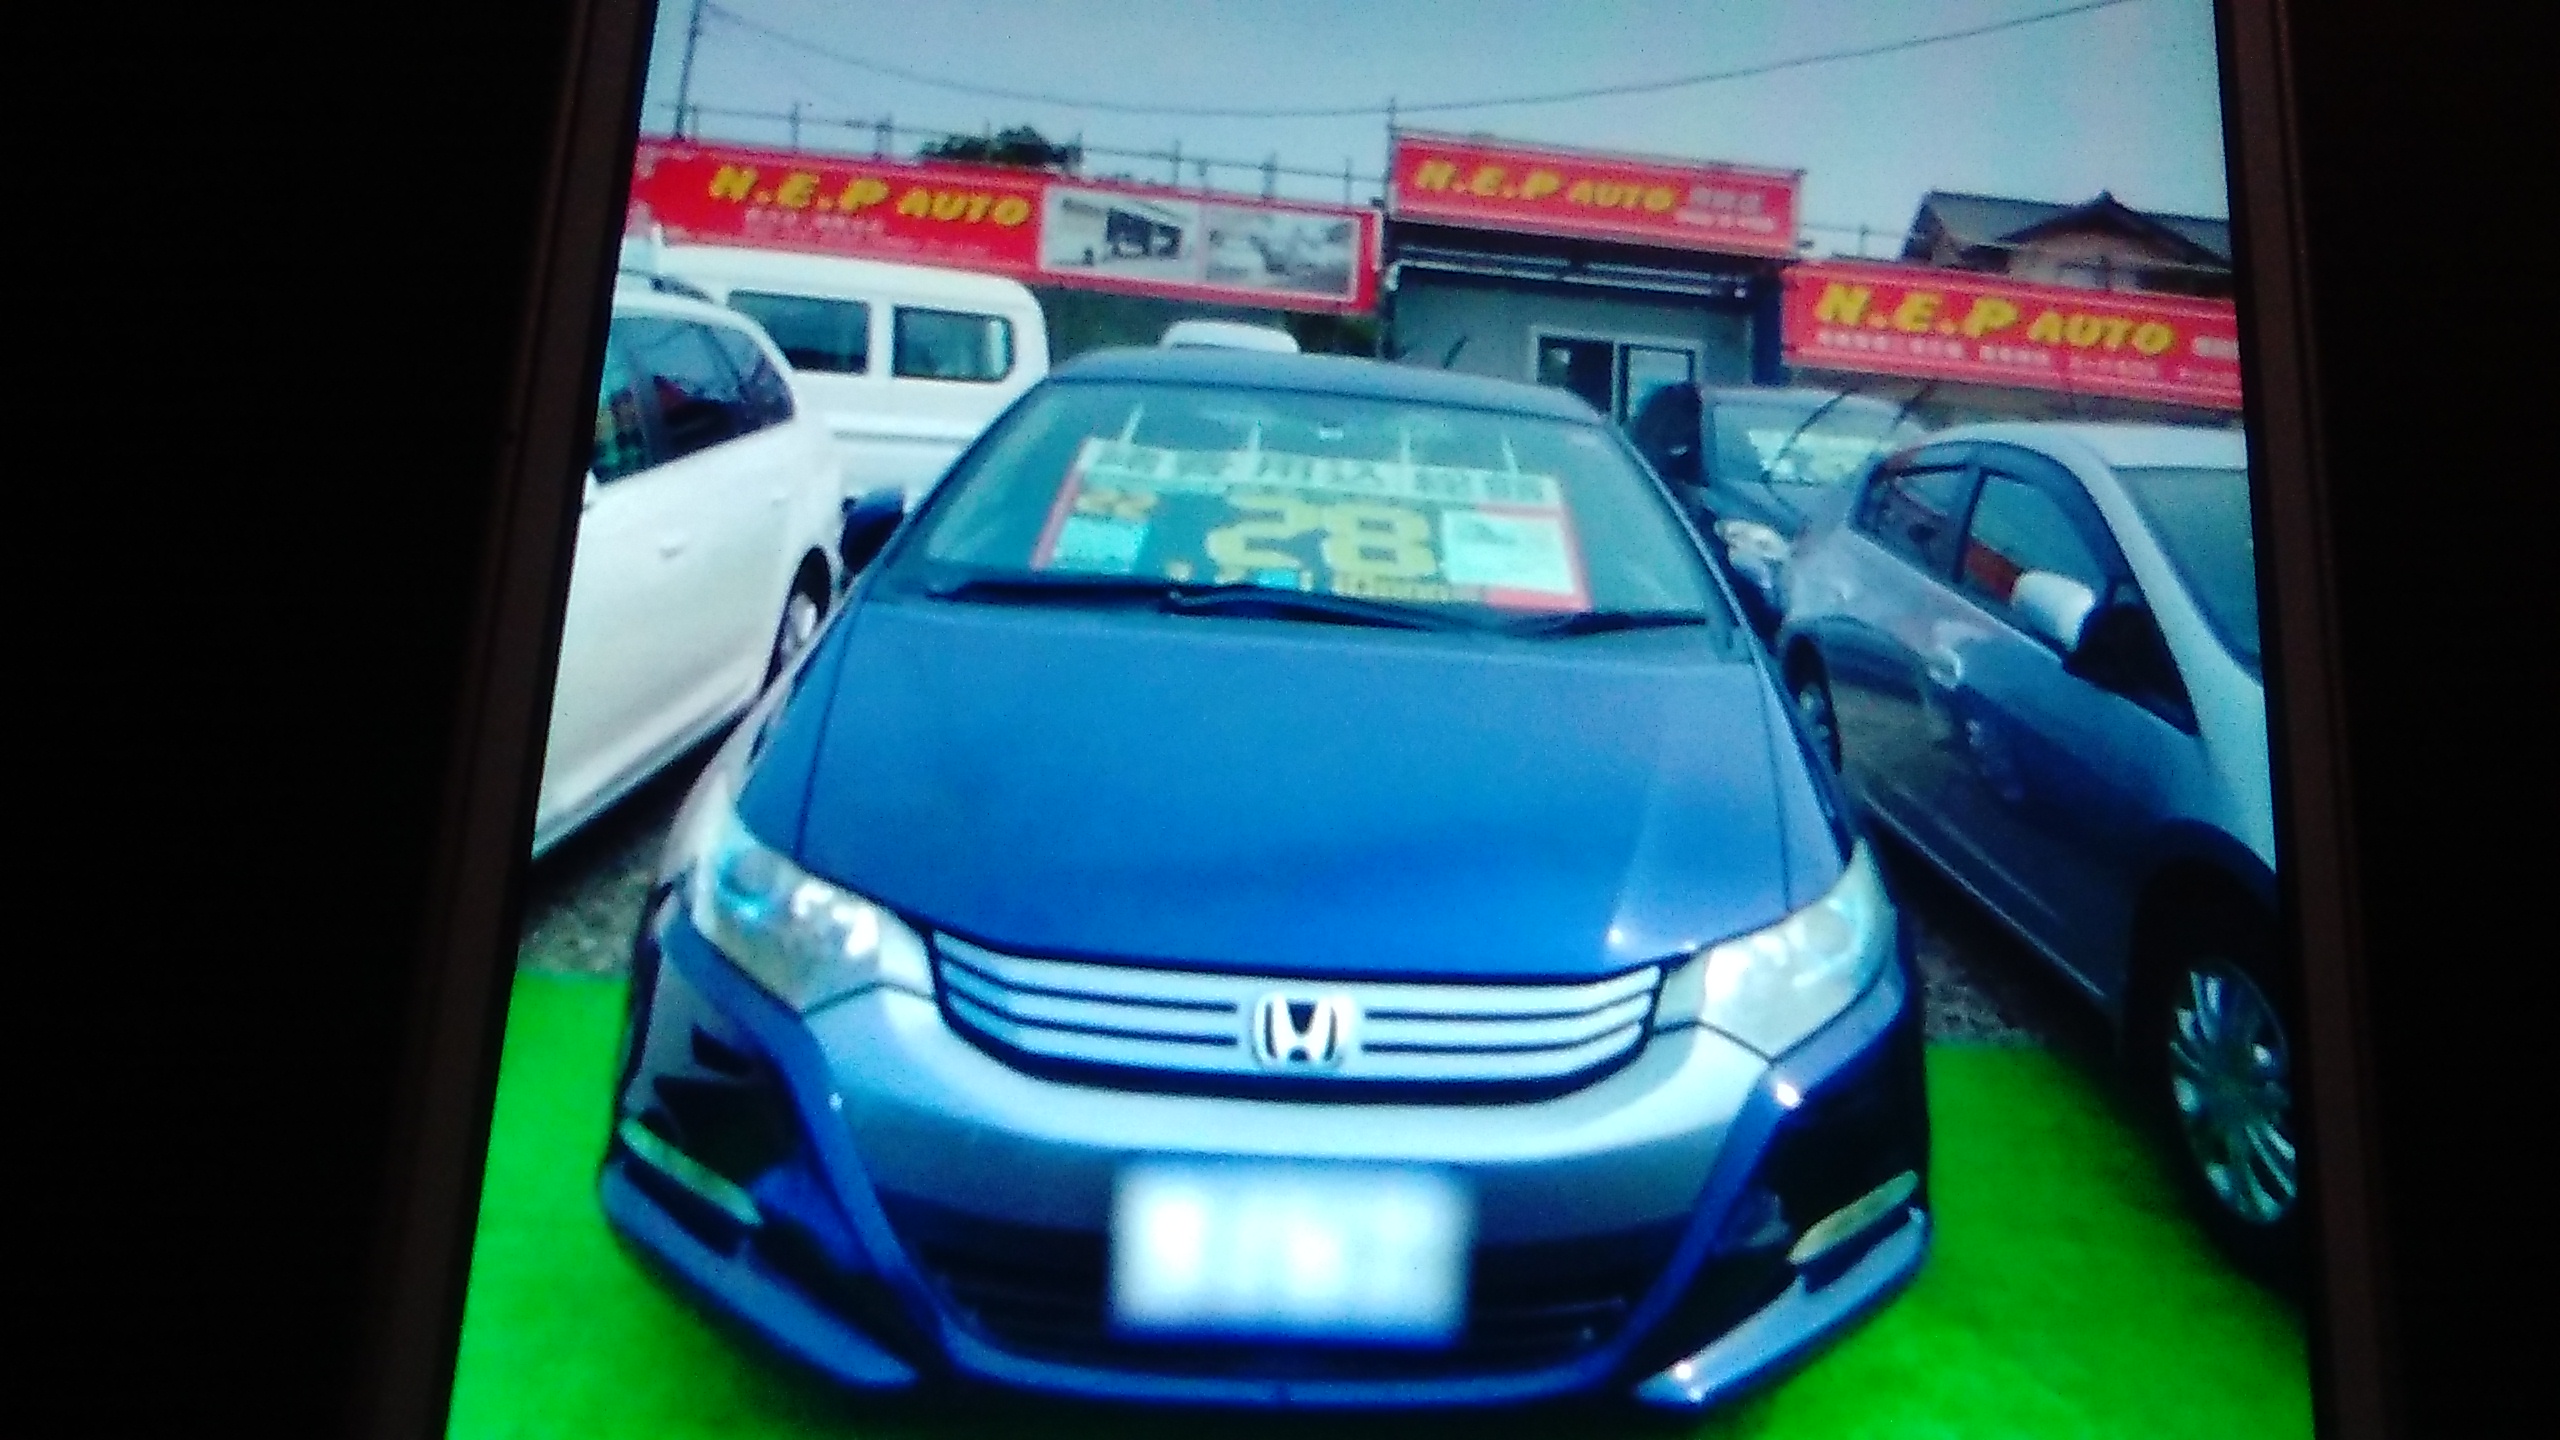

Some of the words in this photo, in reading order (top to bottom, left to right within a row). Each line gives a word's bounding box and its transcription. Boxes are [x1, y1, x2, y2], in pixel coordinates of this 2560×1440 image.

[708, 165, 888, 213] N.E.P
[899, 188, 1031, 227] AUTO
[1569, 180, 1676, 213] AUTO
[1815, 283, 2020, 339] N.E.P
[2028, 310, 2176, 356] AUTO
